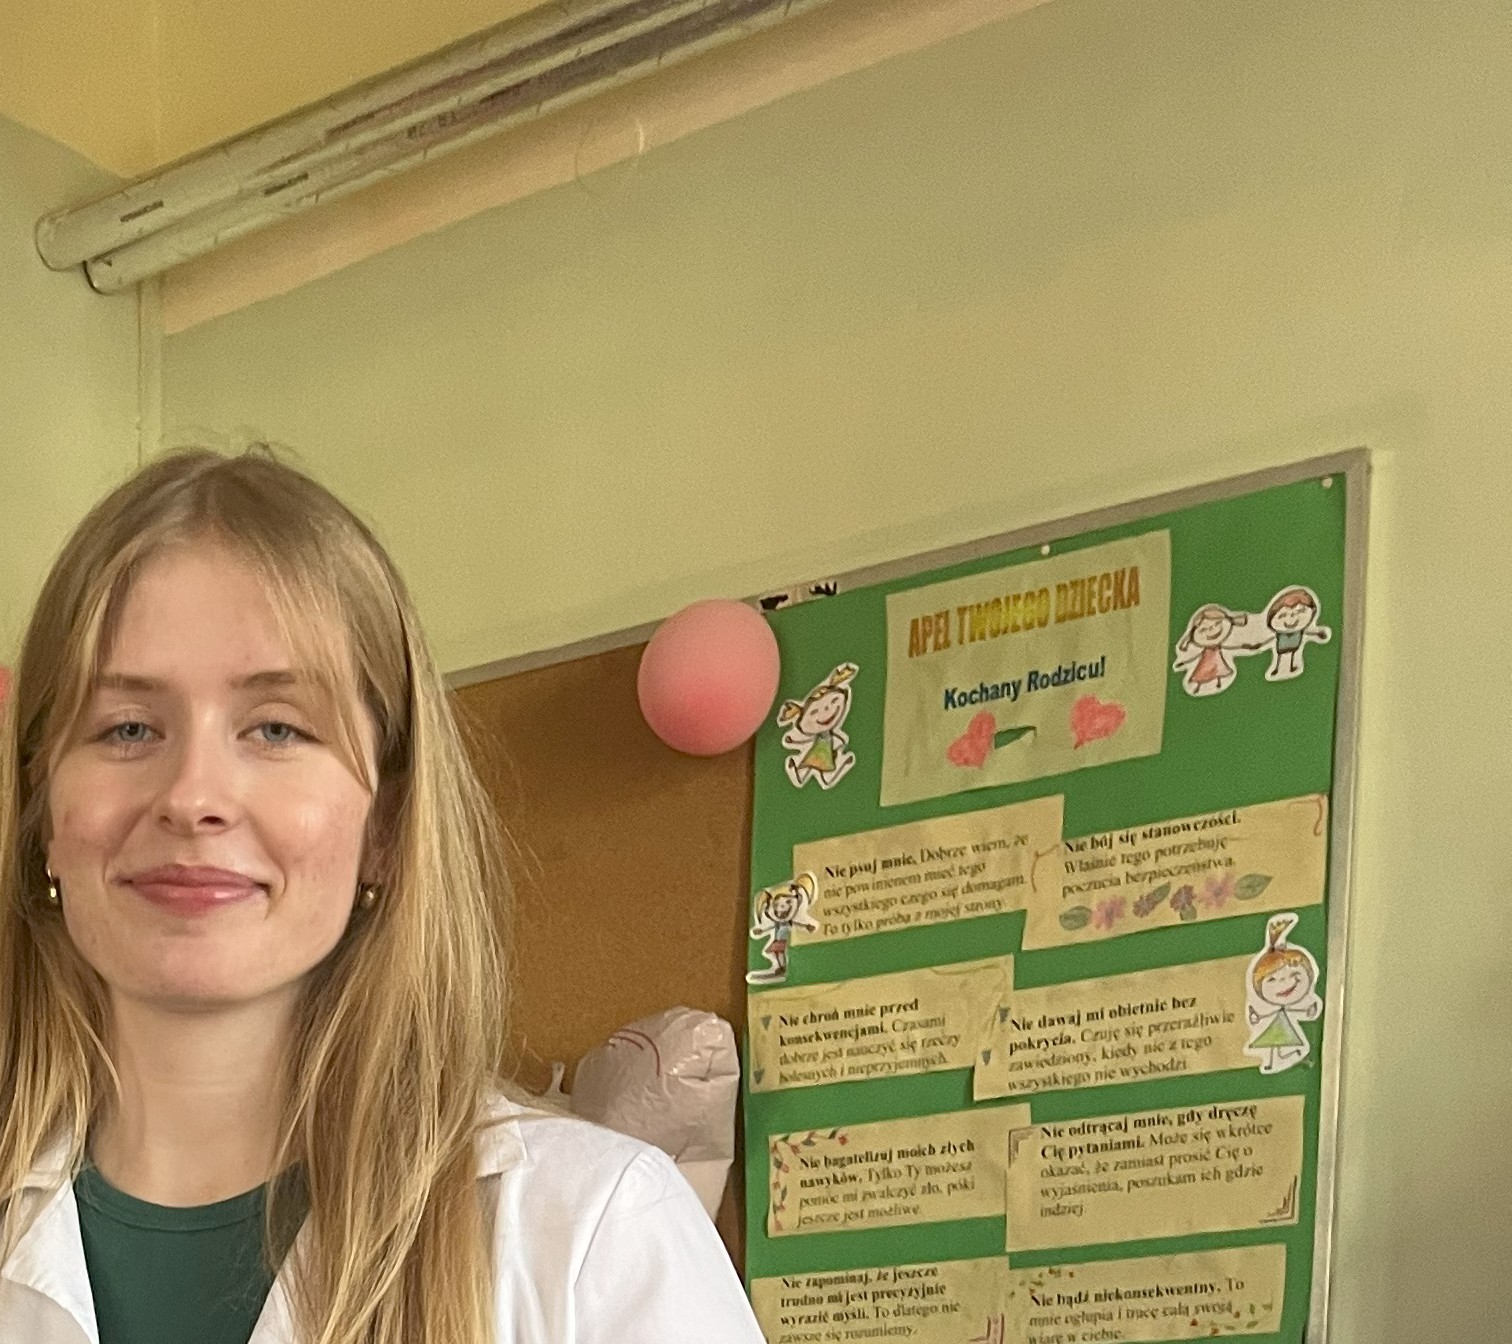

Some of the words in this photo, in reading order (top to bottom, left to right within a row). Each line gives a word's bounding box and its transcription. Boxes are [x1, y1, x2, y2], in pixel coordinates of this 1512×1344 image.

[908, 609, 951, 658] APEL
[957, 587, 1050, 645] TWOJEGO
[1054, 565, 1140, 624] DZIECKA
[944, 679, 1021, 710] Kochany
[1027, 656, 1105, 692] Rodzicu!
[1064, 840, 1087, 852] Nie
[1090, 834, 1113, 849] bój
[1118, 831, 1137, 845] się
[824, 865, 847, 878] Nie
[920, 847, 967, 863] Dobrze
[958, 863, 986, 878] tego
[1064, 854, 1116, 873] Właśnie
[1121, 850, 1151, 866] tego
[941, 886, 960, 899] się
[823, 923, 838, 936] To
[841, 919, 873, 936] tylko
[876, 911, 912, 930] próba
[779, 1014, 799, 1027] Nie
[844, 1004, 876, 1019] mnie
[880, 998, 919, 1018] przed
[1011, 1017, 1034, 1032] Nie
[1038, 1009, 1081, 1029] dawaj
[1087, 1007, 1105, 1021] mi
[1109, 998, 1168, 1019] obietnic
[1172, 996, 1197, 1009] bez
[779, 1022, 888, 1047] konsekwencjami.
[892, 1015, 946, 1033] Czasami
[1009, 1032, 1076, 1055] pokrycia.
[1080, 1024, 1120, 1043] Czuję
[1124, 1020, 1144, 1037] się
[1148, 1009, 1236, 1036] przeraźliwie
[779, 1050, 820, 1066] dobrze
[822, 1046, 843, 1062] jest
[900, 1036, 918, 1050] się
[1101, 1044, 1137, 1060] kiedy
[1169, 1039, 1177, 1050] z
[1181, 1034, 1212, 1051] tego
[1008, 1068, 1090, 1091] wszystkiego
[1094, 1068, 1116, 1080] nie
[1041, 1125, 1065, 1139] Nie
[1069, 1116, 1129, 1137] odtrącaj
[1134, 1113, 1173, 1129] mnie,
[1177, 1109, 1202, 1127] gdy
[1209, 1103, 1258, 1122] dręczę
[800, 1155, 820, 1169] Nie
[824, 1147, 893, 1169] bagatelizuj
[897, 1142, 936, 1159] moich
[940, 1138, 975, 1156] złych
[1041, 1143, 1065, 1161] Cię
[1069, 1135, 1144, 1159] pytaniami.
[1149, 1131, 1187, 1146] Może
[1192, 1127, 1211, 1144] się
[1095, 1159, 1109, 1174] że
[1114, 1152, 1164, 1172] zamiast
[1169, 1147, 1211, 1168] prosić
[1215, 1144, 1239, 1160] Cię
[1244, 1145, 1253, 1156] o
[800, 1173, 862, 1188] nawyków.
[868, 1167, 902, 1182] Tylko
[907, 1164, 920, 1178] Ty
[843, 1190, 858, 1201] mi
[947, 1175, 975, 1196] póki
[1127, 1169, 1196, 1193] poszukam
[1201, 1166, 1221, 1181] ich
[1225, 1162, 1264, 1181] gdzie
[844, 1208, 864, 1222] jest
[782, 1276, 801, 1289] Nie
[877, 1268, 888, 1281] że
[893, 1266, 938, 1283] jeszcze
[781, 1293, 823, 1308] trudno
[827, 1291, 843, 1303] mi
[846, 1288, 868, 1306] jest
[872, 1282, 946, 1303] precyzyjnie
[1031, 1293, 1054, 1307] Nie
[1057, 1290, 1089, 1309] bądź
[1094, 1279, 1222, 1303] niekonsekwentny.
[1227, 1277, 1245, 1292] To
[780, 1310, 829, 1328] wyrazić
[833, 1306, 869, 1325] myśli.
[875, 1305, 890, 1318] To
[893, 1302, 938, 1318] dlatego
[779, 1329, 821, 1344] zawsze
[825, 1327, 842, 1341] się
